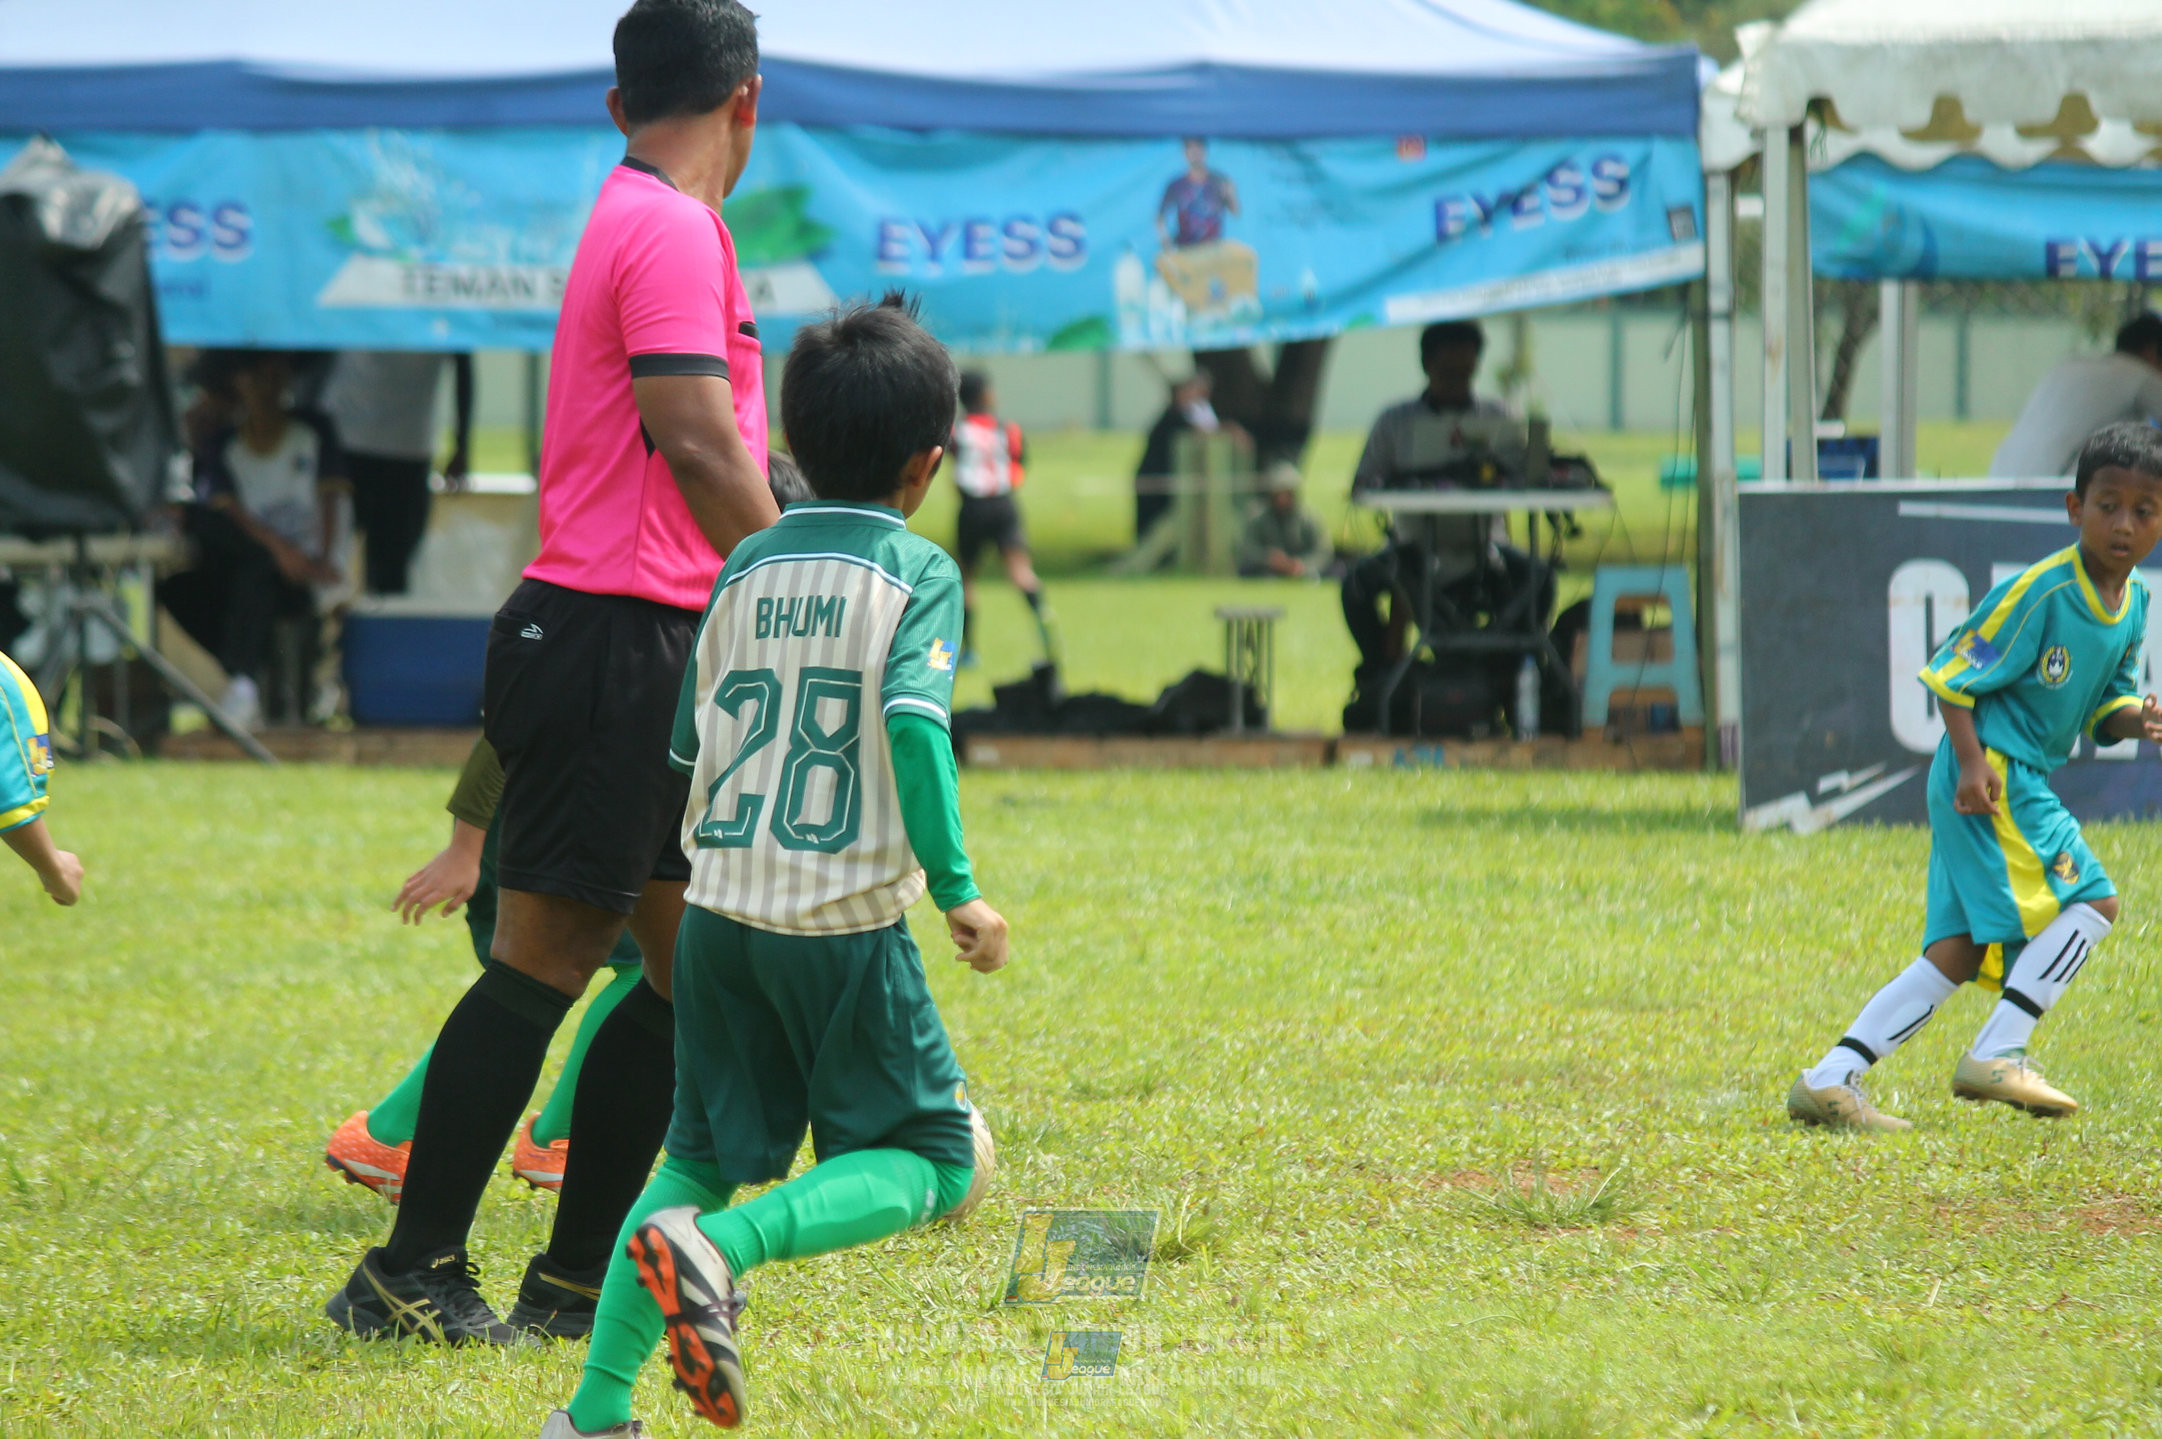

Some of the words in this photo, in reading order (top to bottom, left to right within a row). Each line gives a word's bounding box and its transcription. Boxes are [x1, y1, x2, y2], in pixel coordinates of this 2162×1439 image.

[1435, 153, 1631, 246] EYESS
[876, 210, 1089, 275] EYESS
[401, 264, 534, 298] TEMAN
[755, 596, 847, 640] BHUMI
[694, 667, 863, 855] 28
